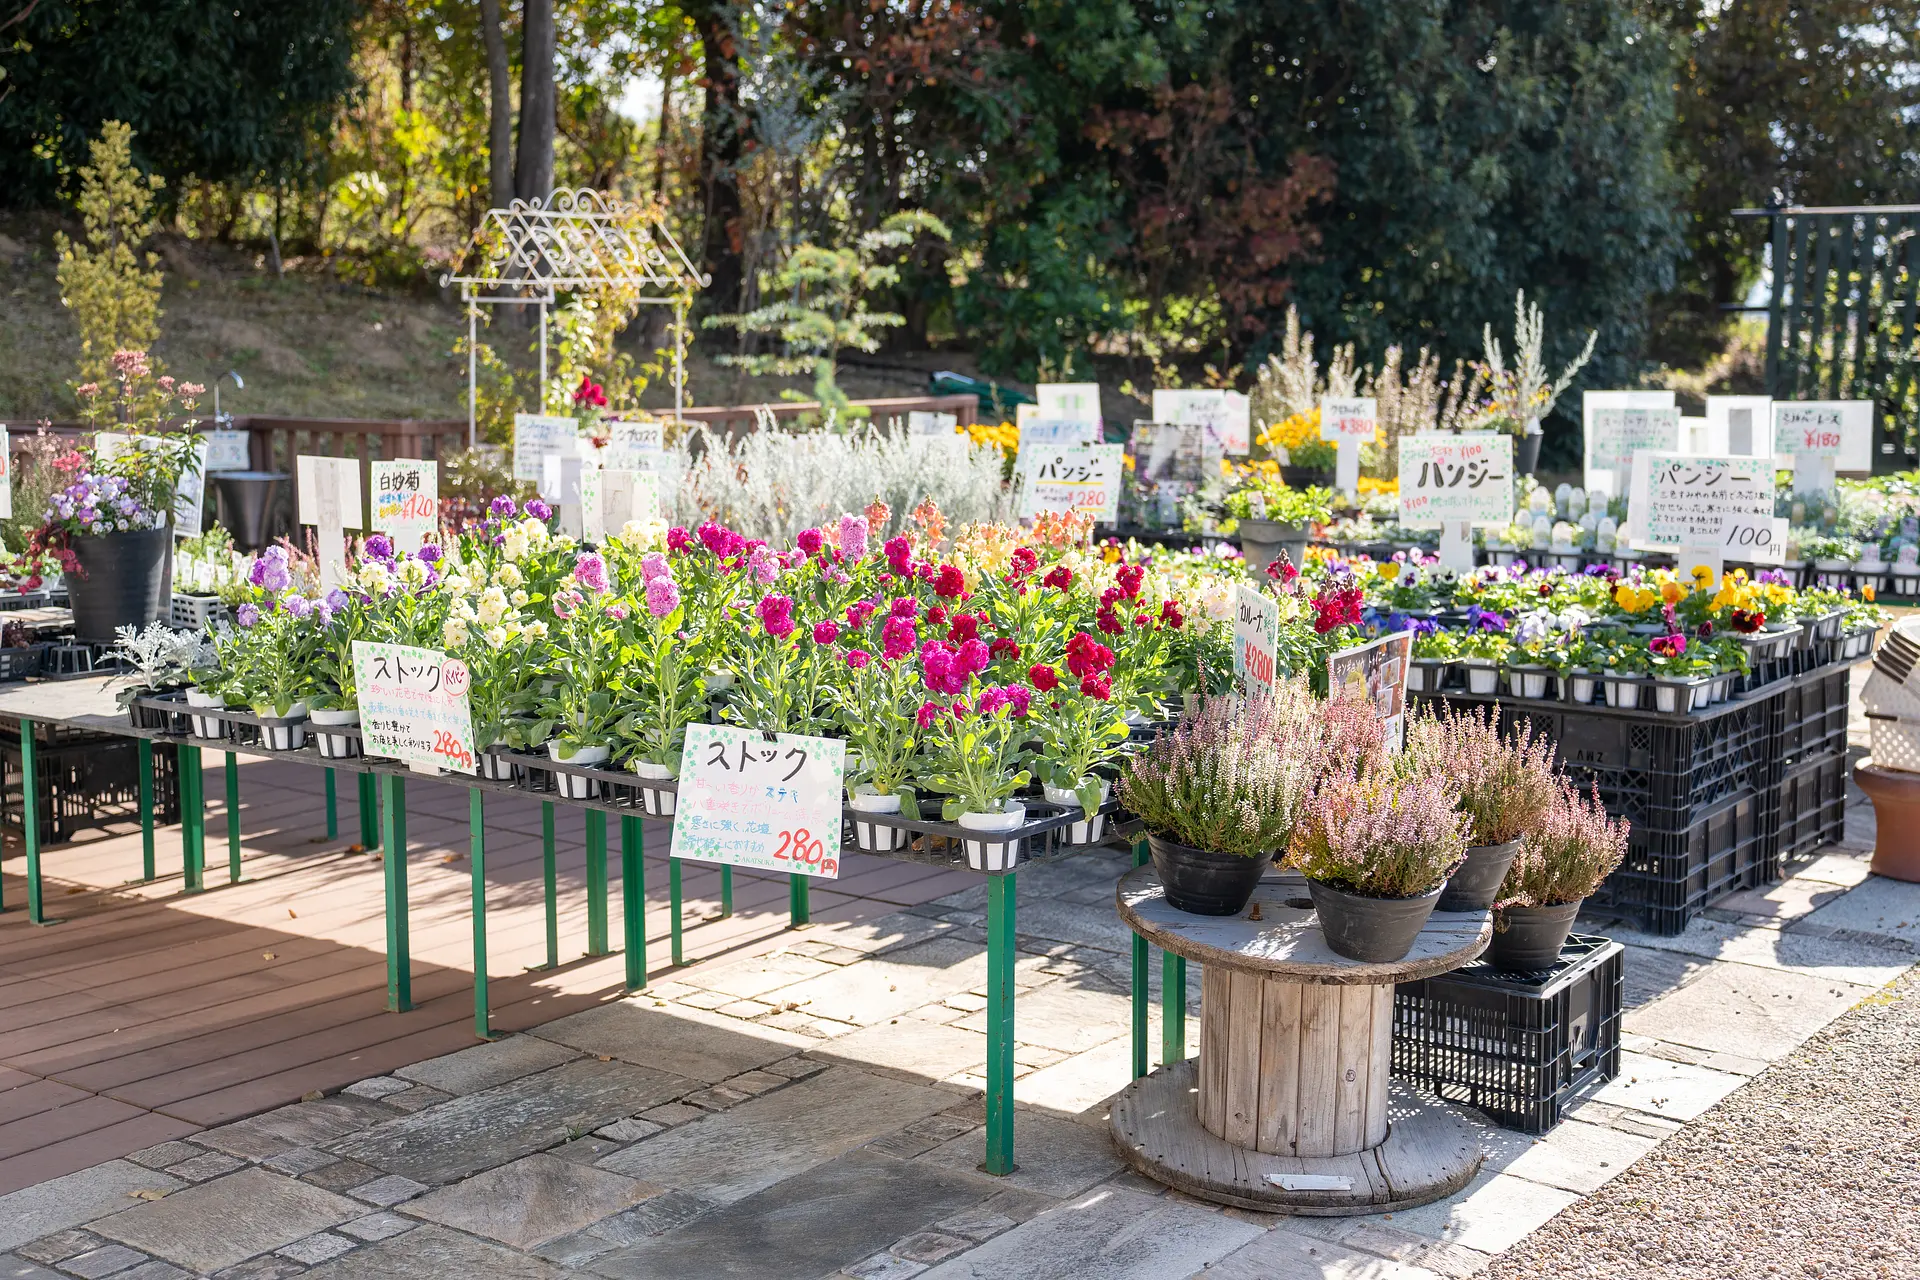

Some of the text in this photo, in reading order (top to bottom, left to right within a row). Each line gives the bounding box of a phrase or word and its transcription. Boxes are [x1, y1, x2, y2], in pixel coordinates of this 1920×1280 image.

[1339, 418, 1373, 435] ¥380
[1803, 428, 1840, 449] ¥180
[380, 469, 419, 491] 白妙菊
[1039, 457, 1103, 482] パンジー
[1417, 459, 1504, 488] パンジー
[1659, 463, 1751, 486] パンジー
[402, 492, 433, 520] ¥120
[1067, 490, 1106, 507] ¥280
[1240, 602, 1263, 633] カルーナ
[373, 656, 440, 692] ストック
[1245, 640, 1273, 687] ¥2800
[707, 740, 808, 782] ストック
